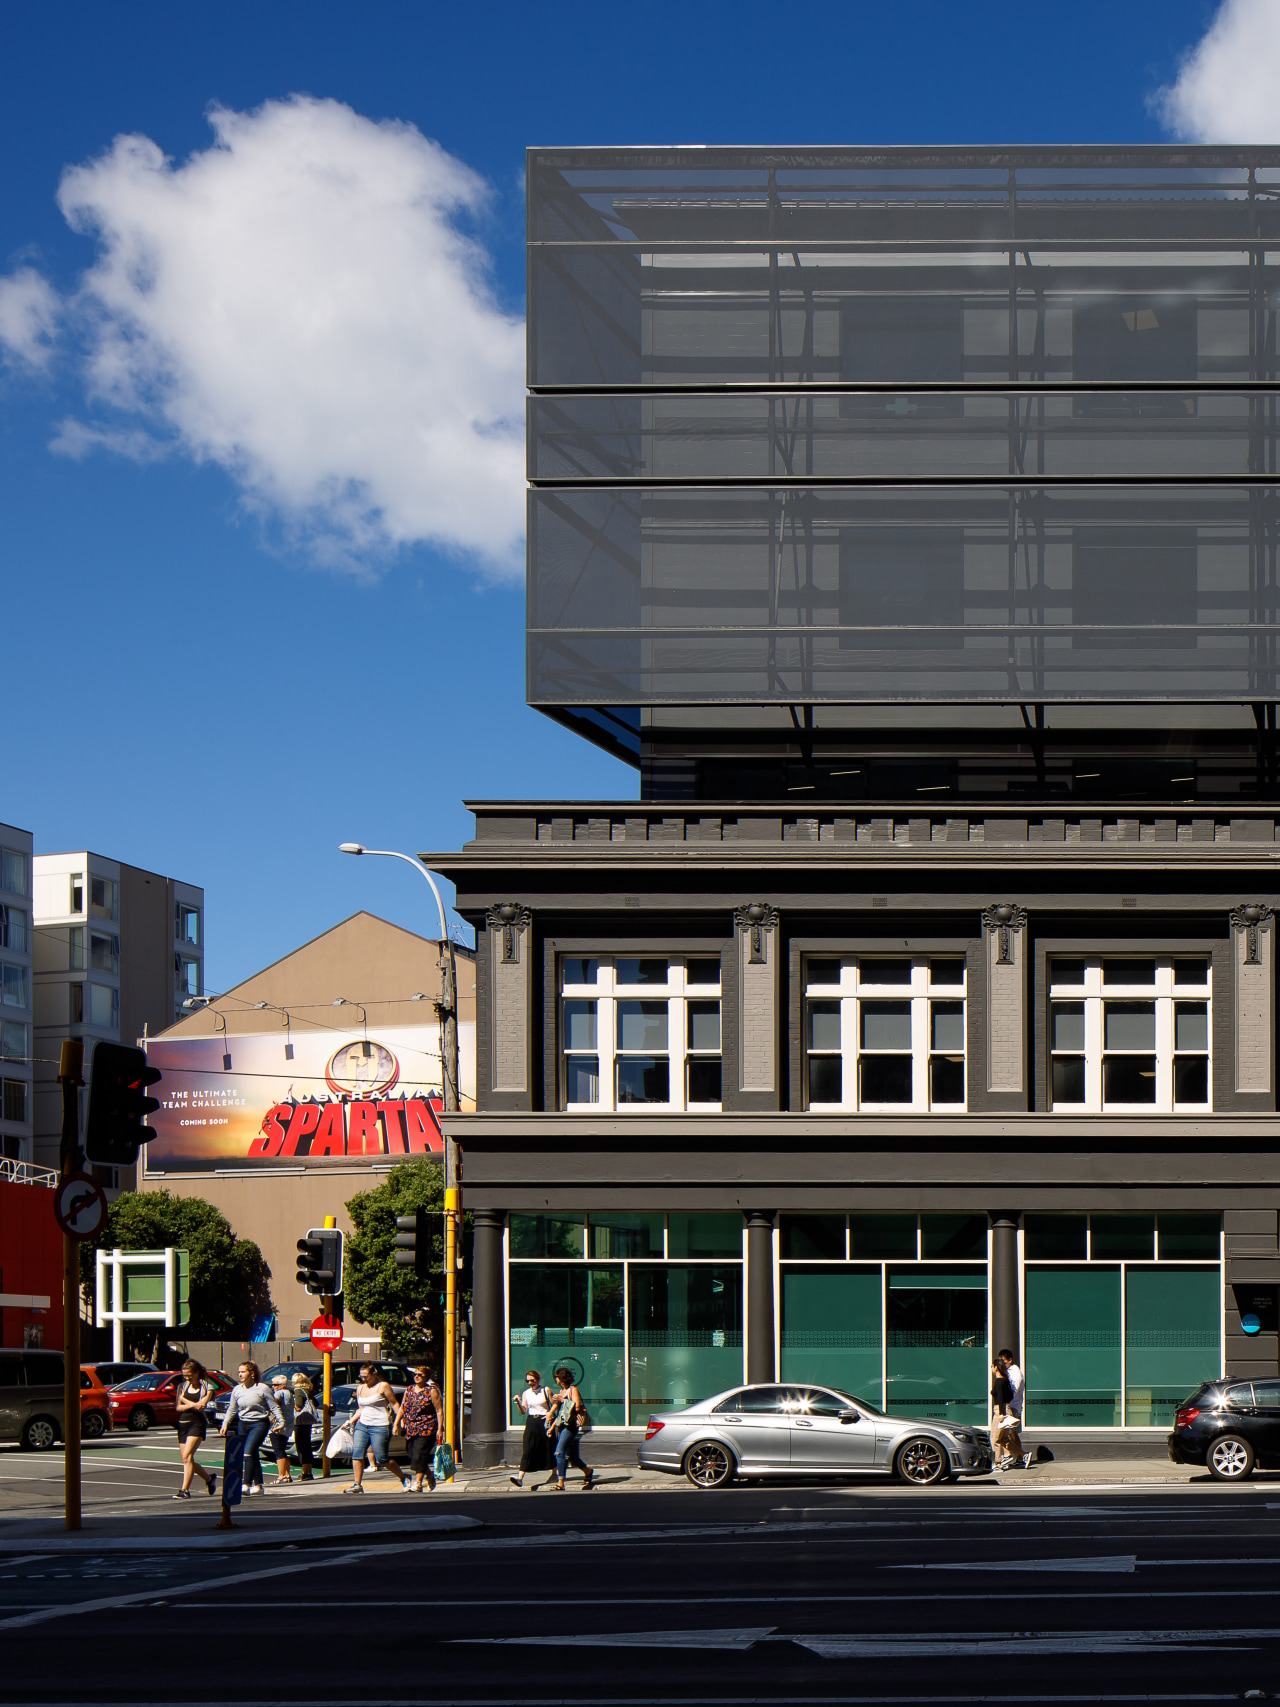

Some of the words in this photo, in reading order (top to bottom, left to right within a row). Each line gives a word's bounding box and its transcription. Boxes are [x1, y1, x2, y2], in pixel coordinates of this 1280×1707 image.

[171, 1091, 188, 1099] THE
[192, 1089, 237, 1098] ULTIMATE
[162, 1101, 188, 1109] TEAM
[192, 1098, 246, 1108] CHALLENGE
